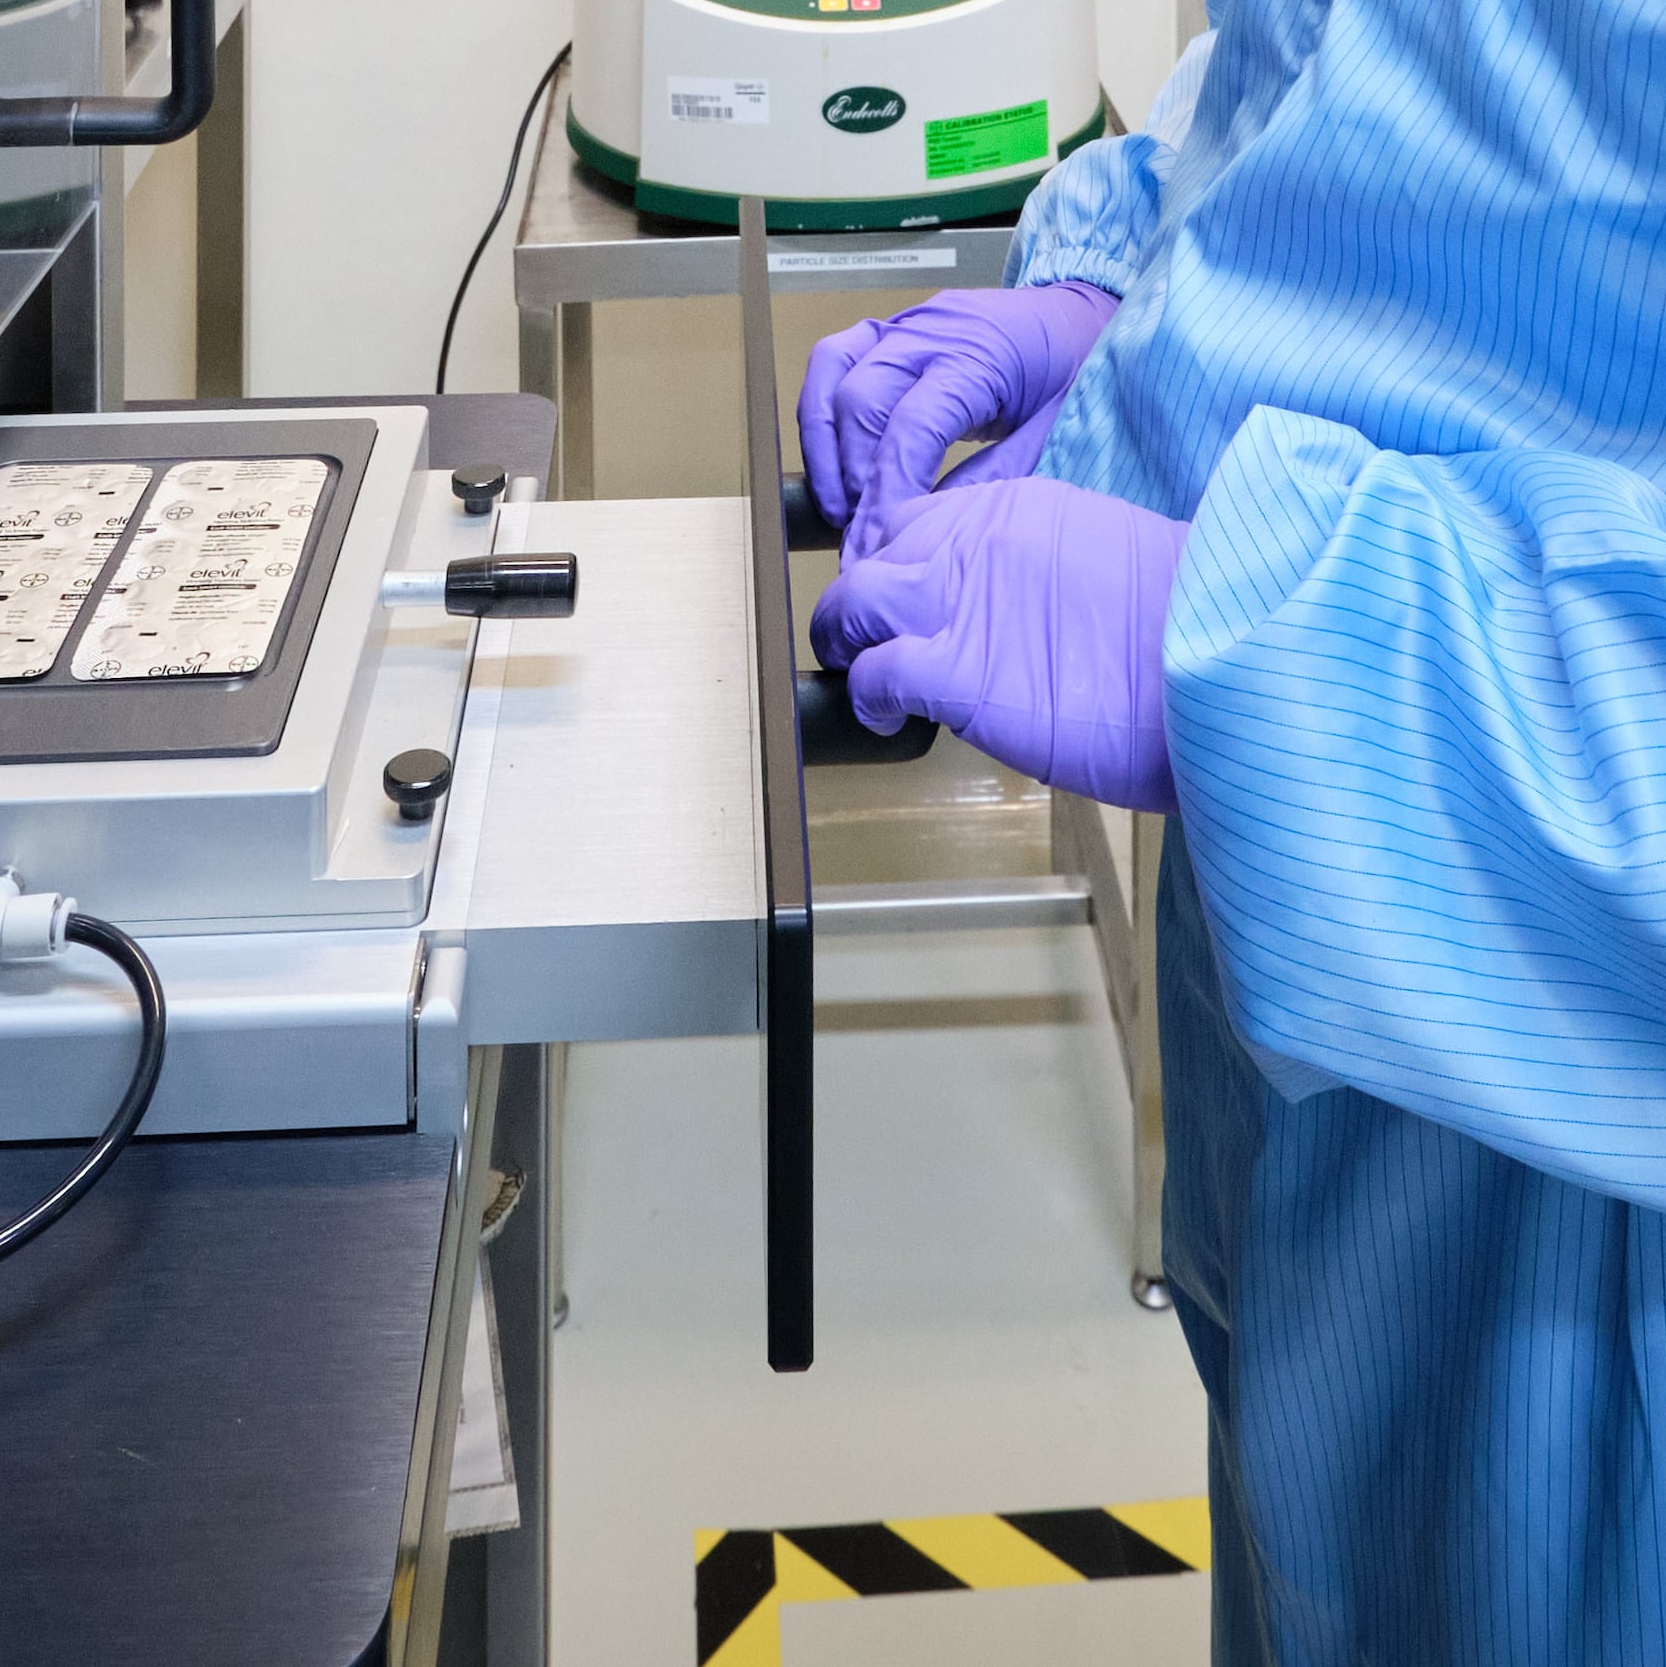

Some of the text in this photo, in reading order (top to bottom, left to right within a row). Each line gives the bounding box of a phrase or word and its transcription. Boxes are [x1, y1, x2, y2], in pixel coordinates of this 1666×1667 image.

[780, 257, 824, 266] PARTICLE
[852, 255, 919, 265] DISTRIBUTION
[217, 507, 266, 520] elevit
[190, 566, 243, 579] elevit
[148, 663, 202, 676] elevit
